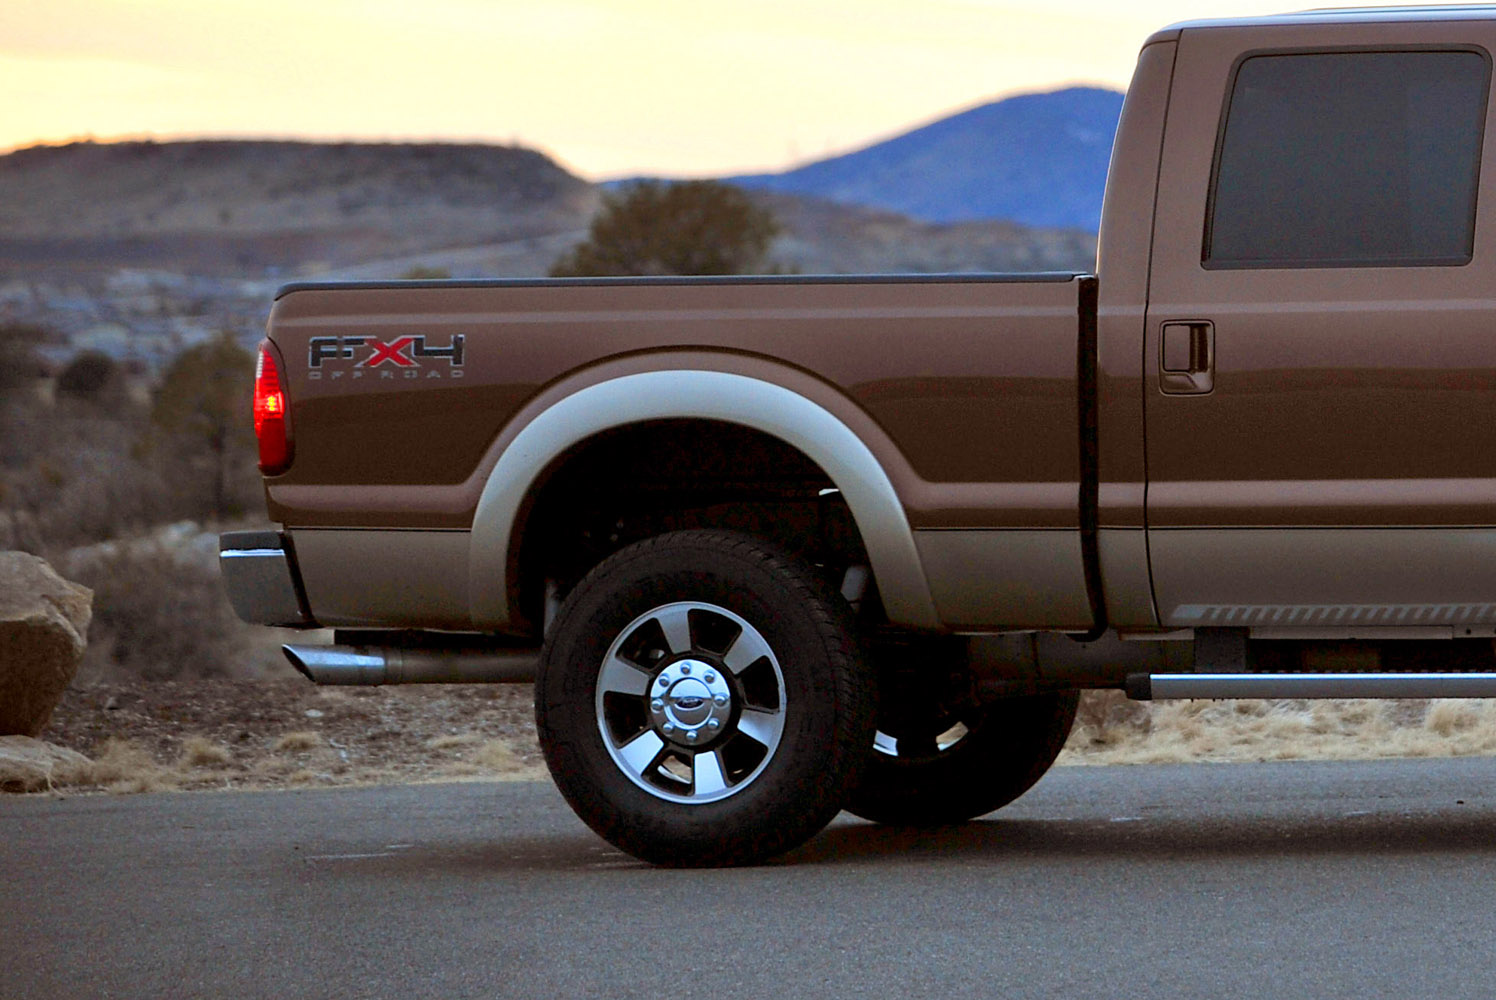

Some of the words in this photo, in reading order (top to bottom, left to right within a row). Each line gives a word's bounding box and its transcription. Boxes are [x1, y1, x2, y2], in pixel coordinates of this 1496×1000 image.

[308, 334, 465, 368] FX4
[308, 370, 364, 380] OFF
[380, 370, 465, 380] ROAD
